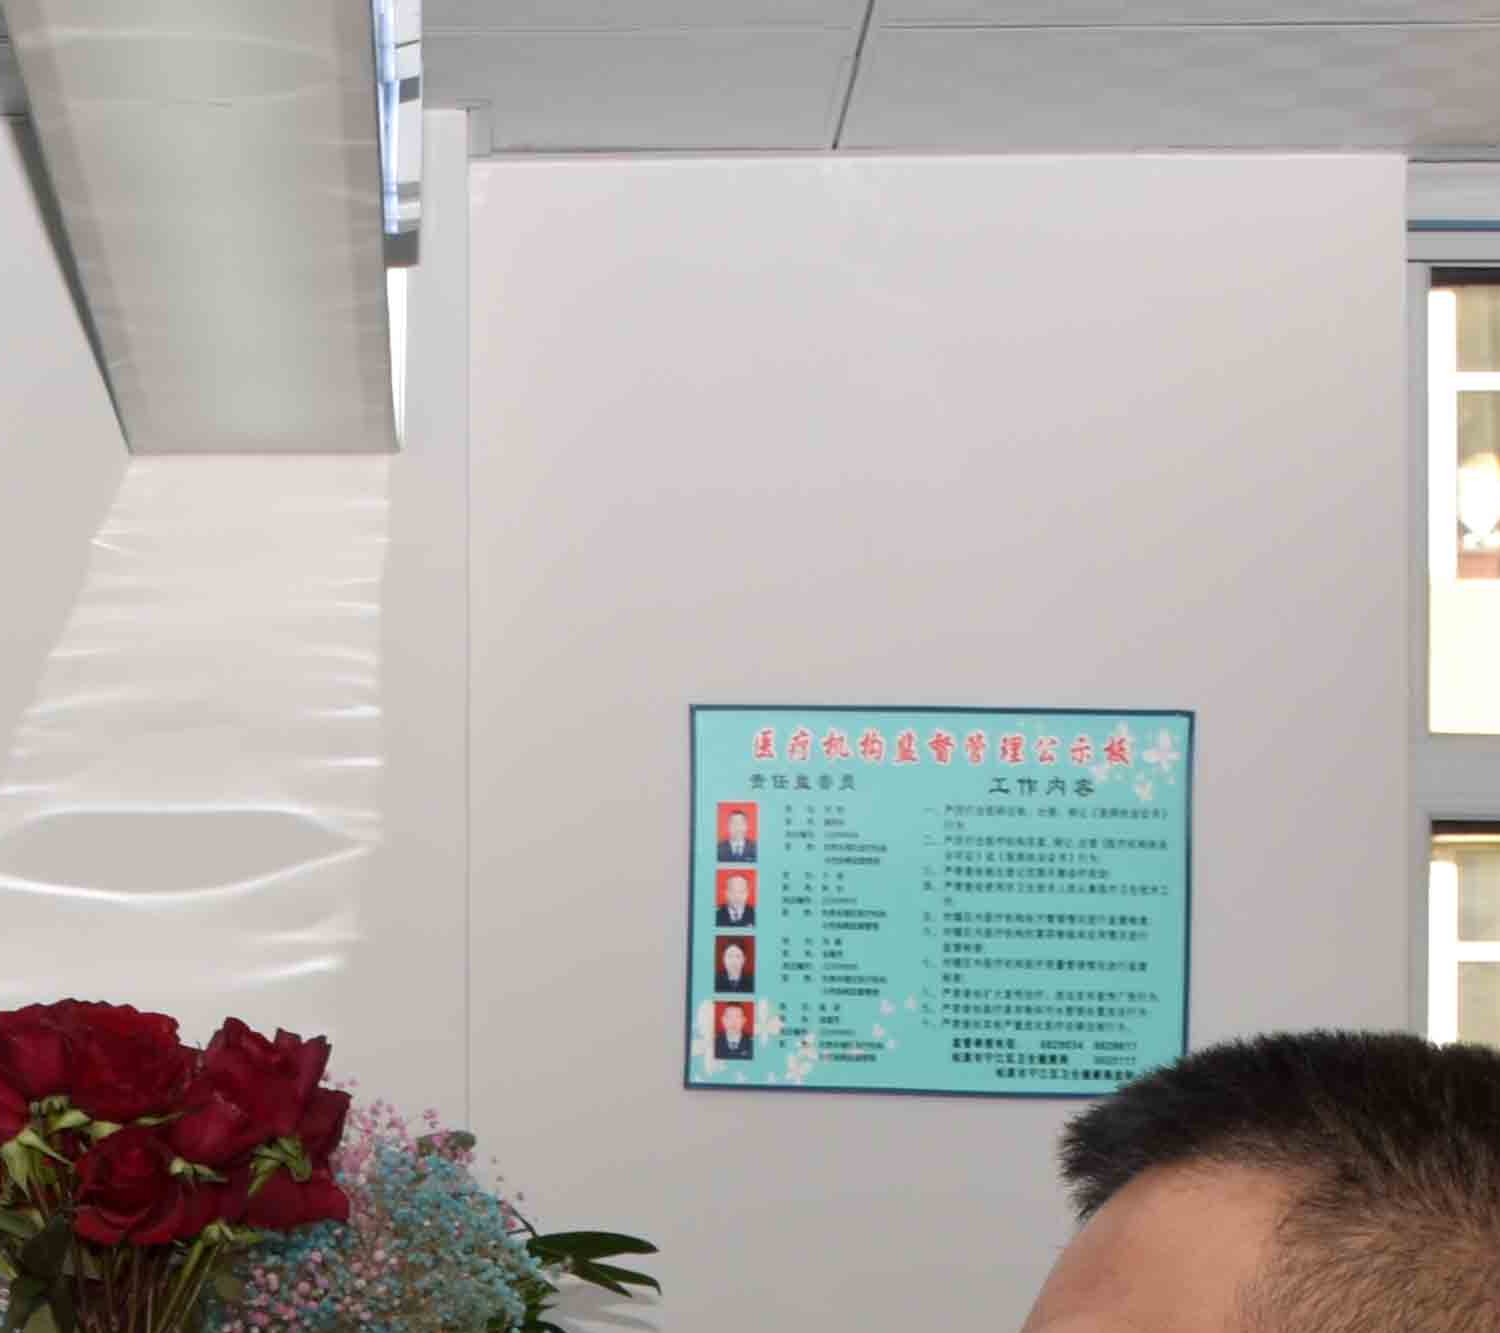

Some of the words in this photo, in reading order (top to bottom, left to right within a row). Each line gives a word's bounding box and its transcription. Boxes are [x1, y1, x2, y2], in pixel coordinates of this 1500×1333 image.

[753, 727, 1132, 766] 医疗机构监督管理公示板
[989, 776, 1095, 797] 工作内容
